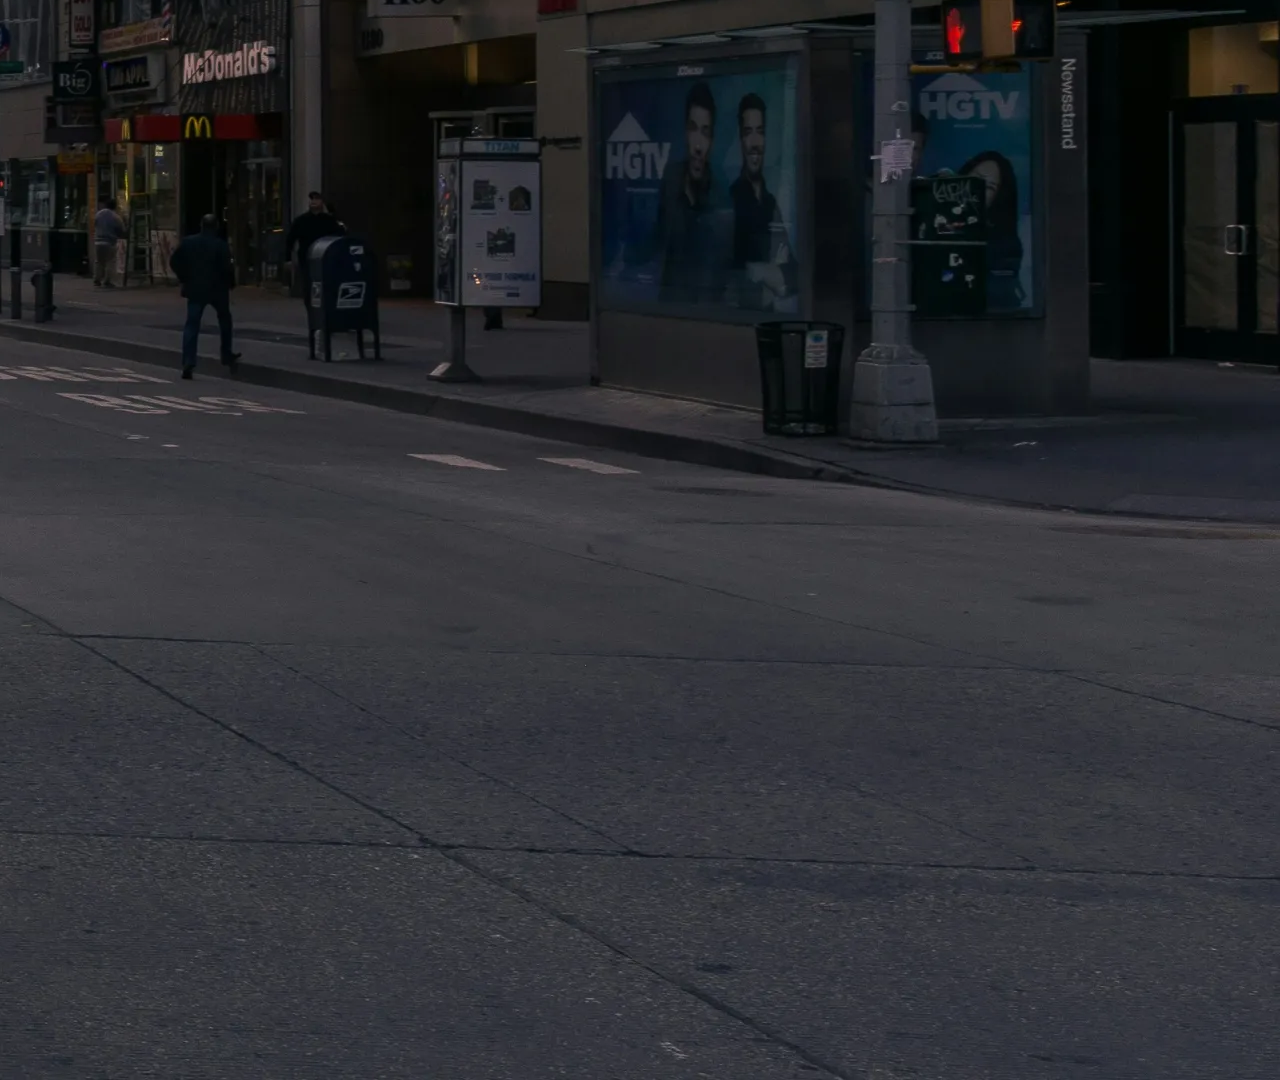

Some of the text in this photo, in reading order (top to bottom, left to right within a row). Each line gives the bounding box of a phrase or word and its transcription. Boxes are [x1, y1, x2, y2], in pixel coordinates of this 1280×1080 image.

[74, 14, 92, 33] GOLD
[361, 28, 383, 51] 1180
[183, 39, 274, 85] McDonald's
[58, 72, 86, 90] Big
[919, 90, 1021, 121] HGTV
[1060, 57, 1078, 150] Newsstand
[483, 141, 520, 153] TITAN
[605, 141, 672, 180] HGTV
